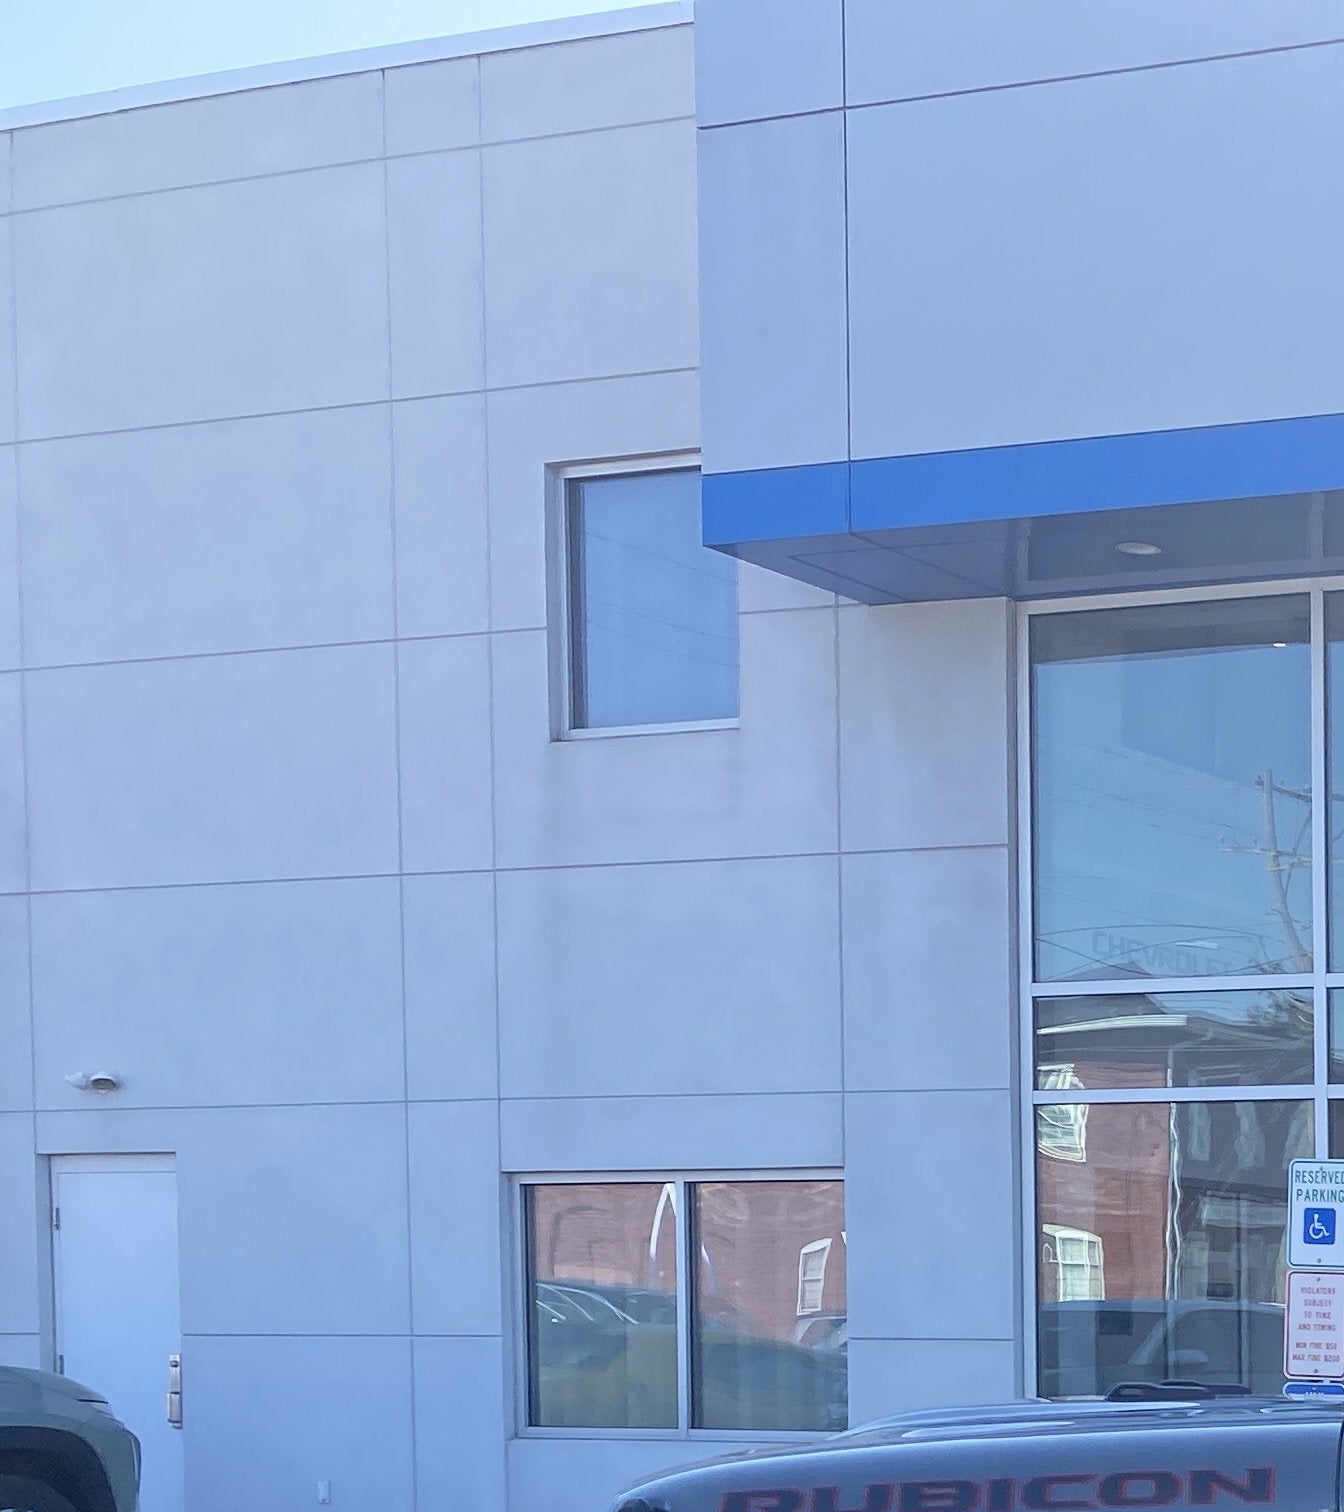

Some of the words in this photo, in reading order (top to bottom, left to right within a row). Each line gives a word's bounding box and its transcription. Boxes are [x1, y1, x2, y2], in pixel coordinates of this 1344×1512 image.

[1296, 1188, 1344, 1203] PARKING
[1300, 1286, 1336, 1295] VIOLATORS
[1304, 1310, 1312, 1319] TO
[1315, 1311, 1332, 1320] FINE
[1298, 1323, 1311, 1331] AND
